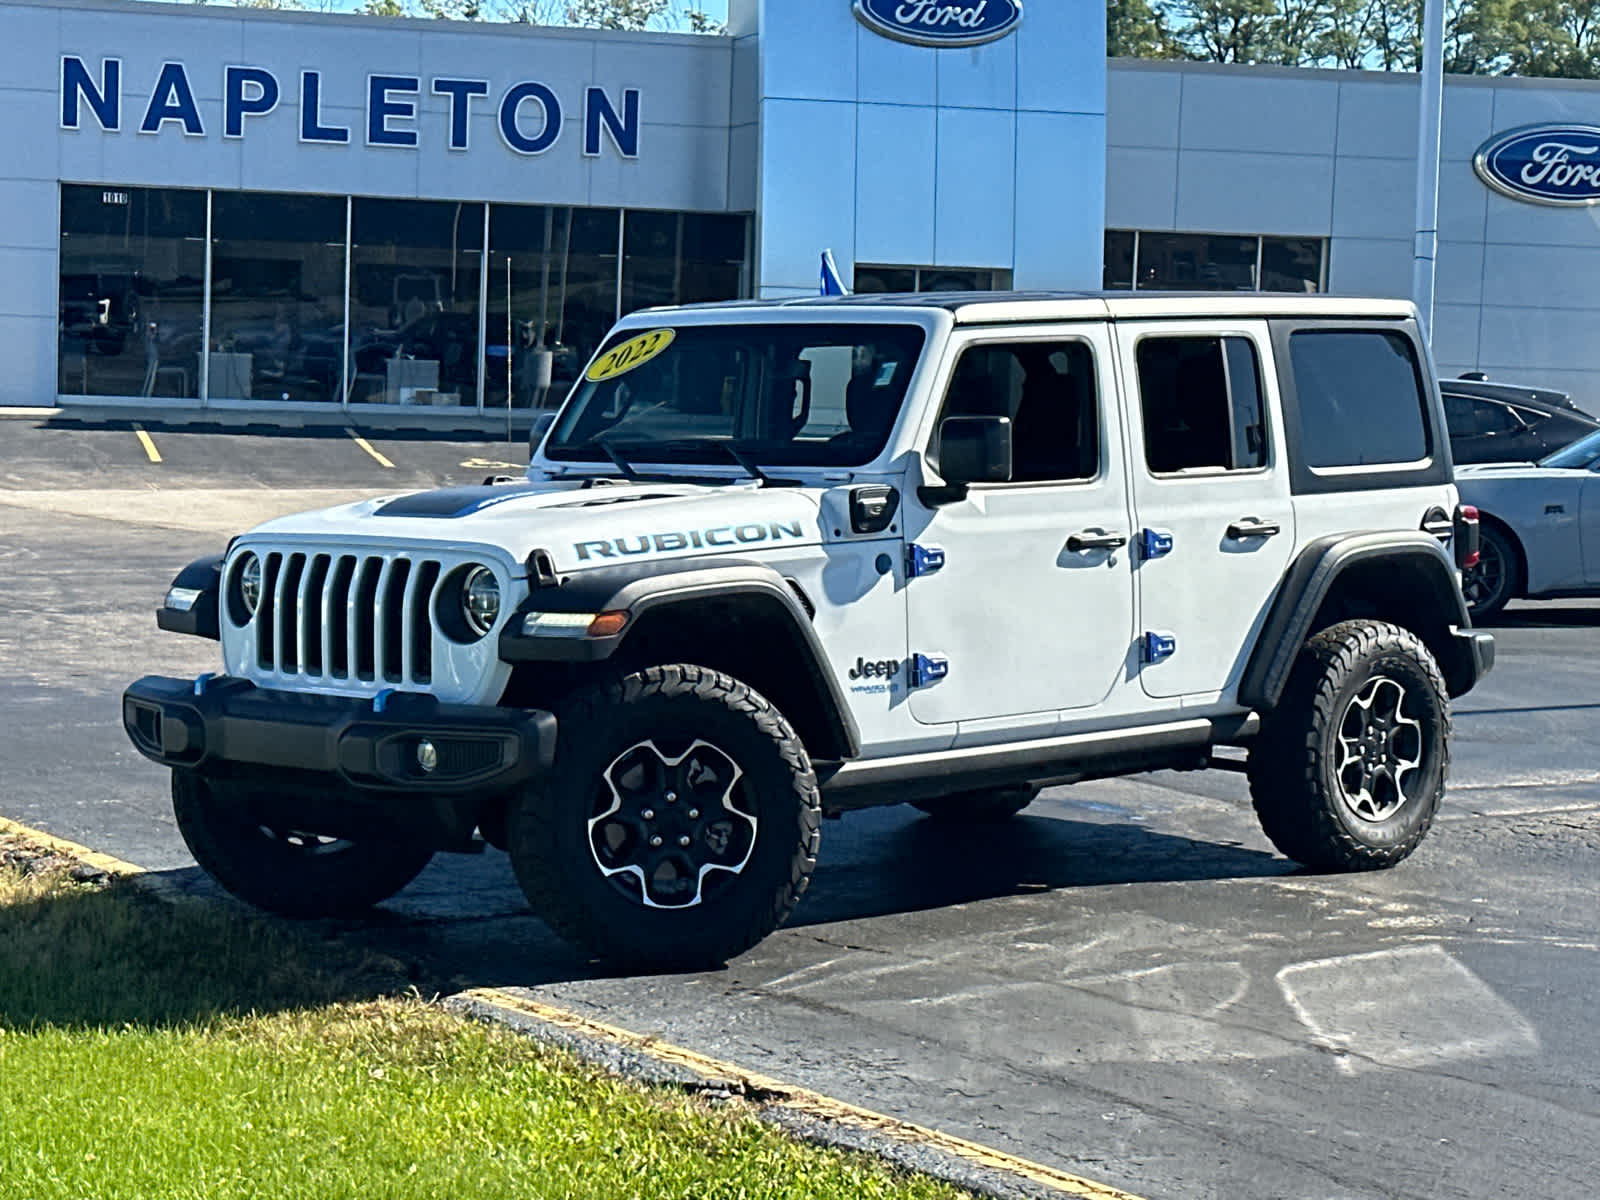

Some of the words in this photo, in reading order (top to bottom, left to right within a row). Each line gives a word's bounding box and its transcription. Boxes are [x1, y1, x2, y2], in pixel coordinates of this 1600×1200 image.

[895, 0, 987, 27] Ford
[60, 55, 640, 158] NAPLETON
[600, 333, 662, 377] 2022
[573, 520, 804, 562] RUBICON
[848, 656, 900, 680] Jeep
